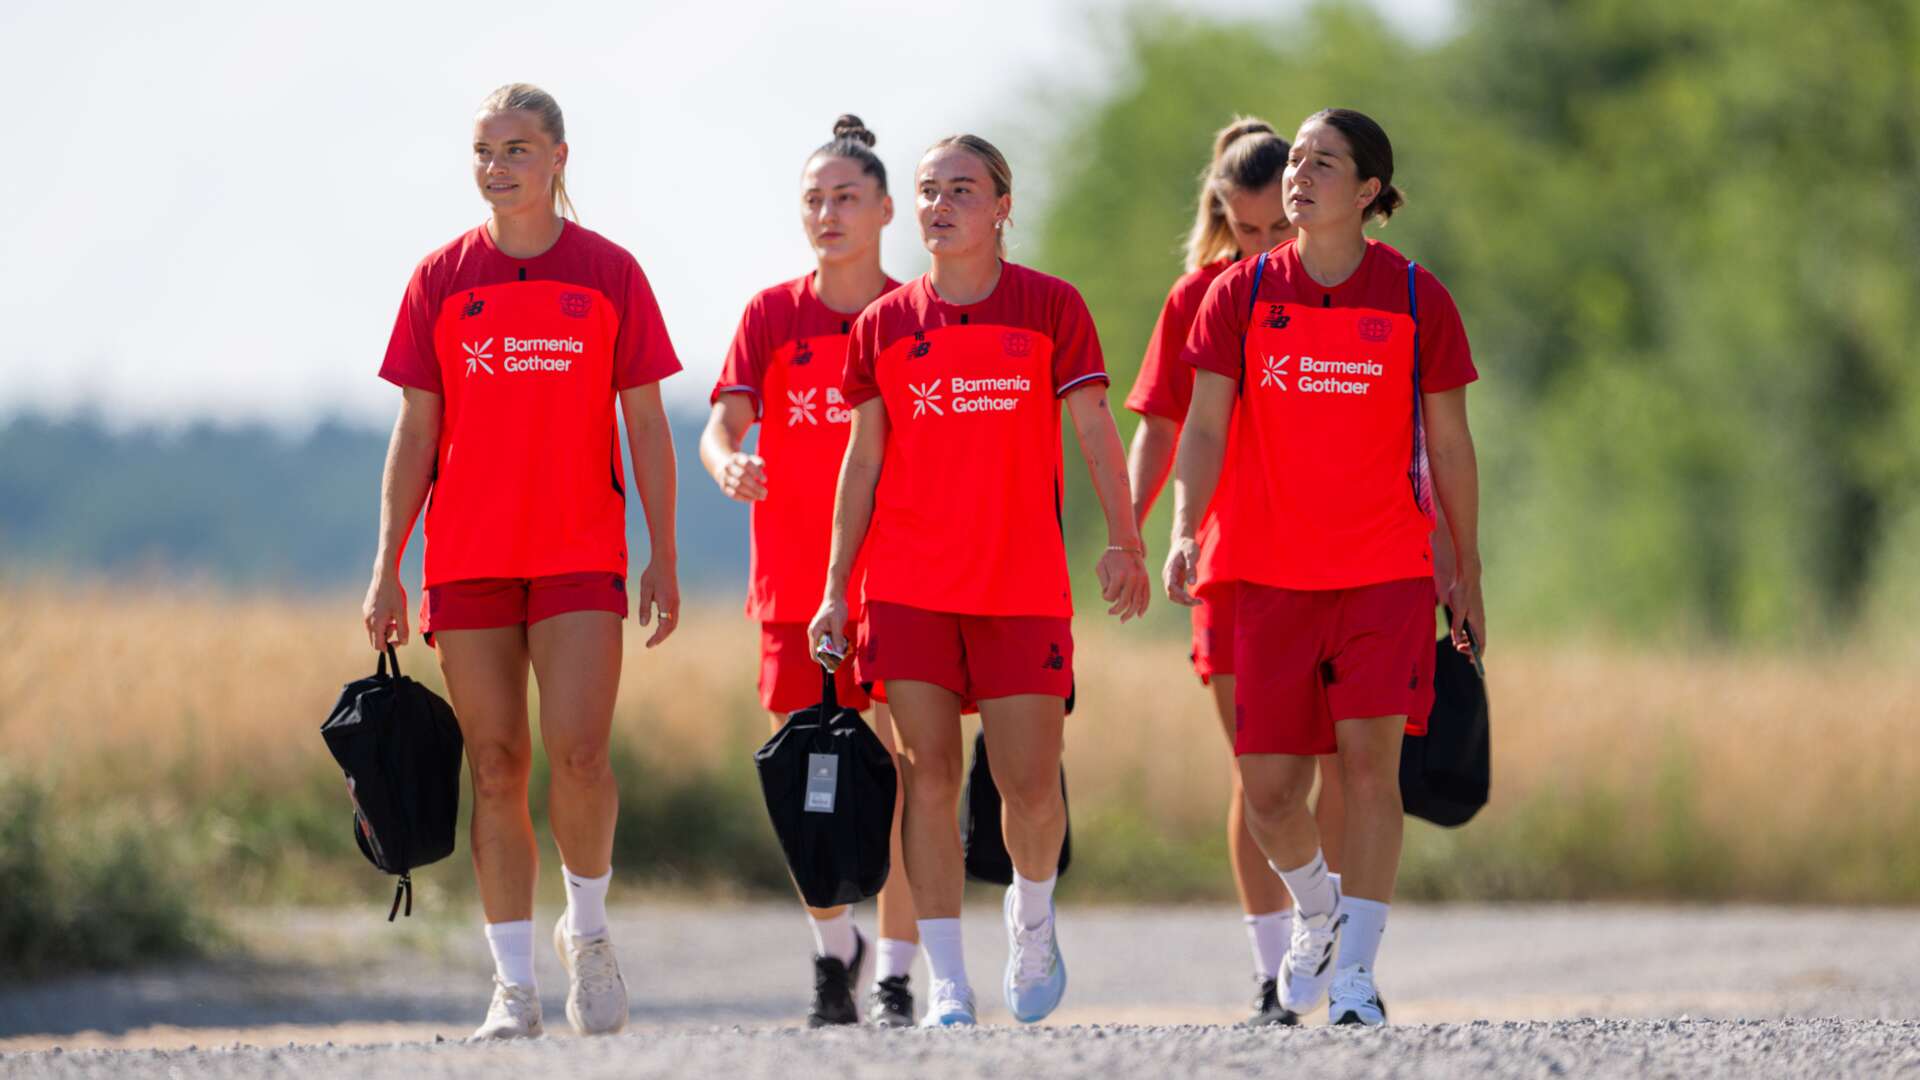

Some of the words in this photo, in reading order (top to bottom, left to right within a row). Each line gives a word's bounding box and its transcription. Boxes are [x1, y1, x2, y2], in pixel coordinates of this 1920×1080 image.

[1269, 304, 1286, 315] 22
[503, 336, 584, 353] Barmenia
[503, 355, 572, 372] Gothaer
[1299, 356, 1384, 377] Barmenia
[951, 375, 1031, 394] Barmenia
[1297, 376, 1370, 395] Gothaer
[951, 395, 1020, 413] Gothaer
